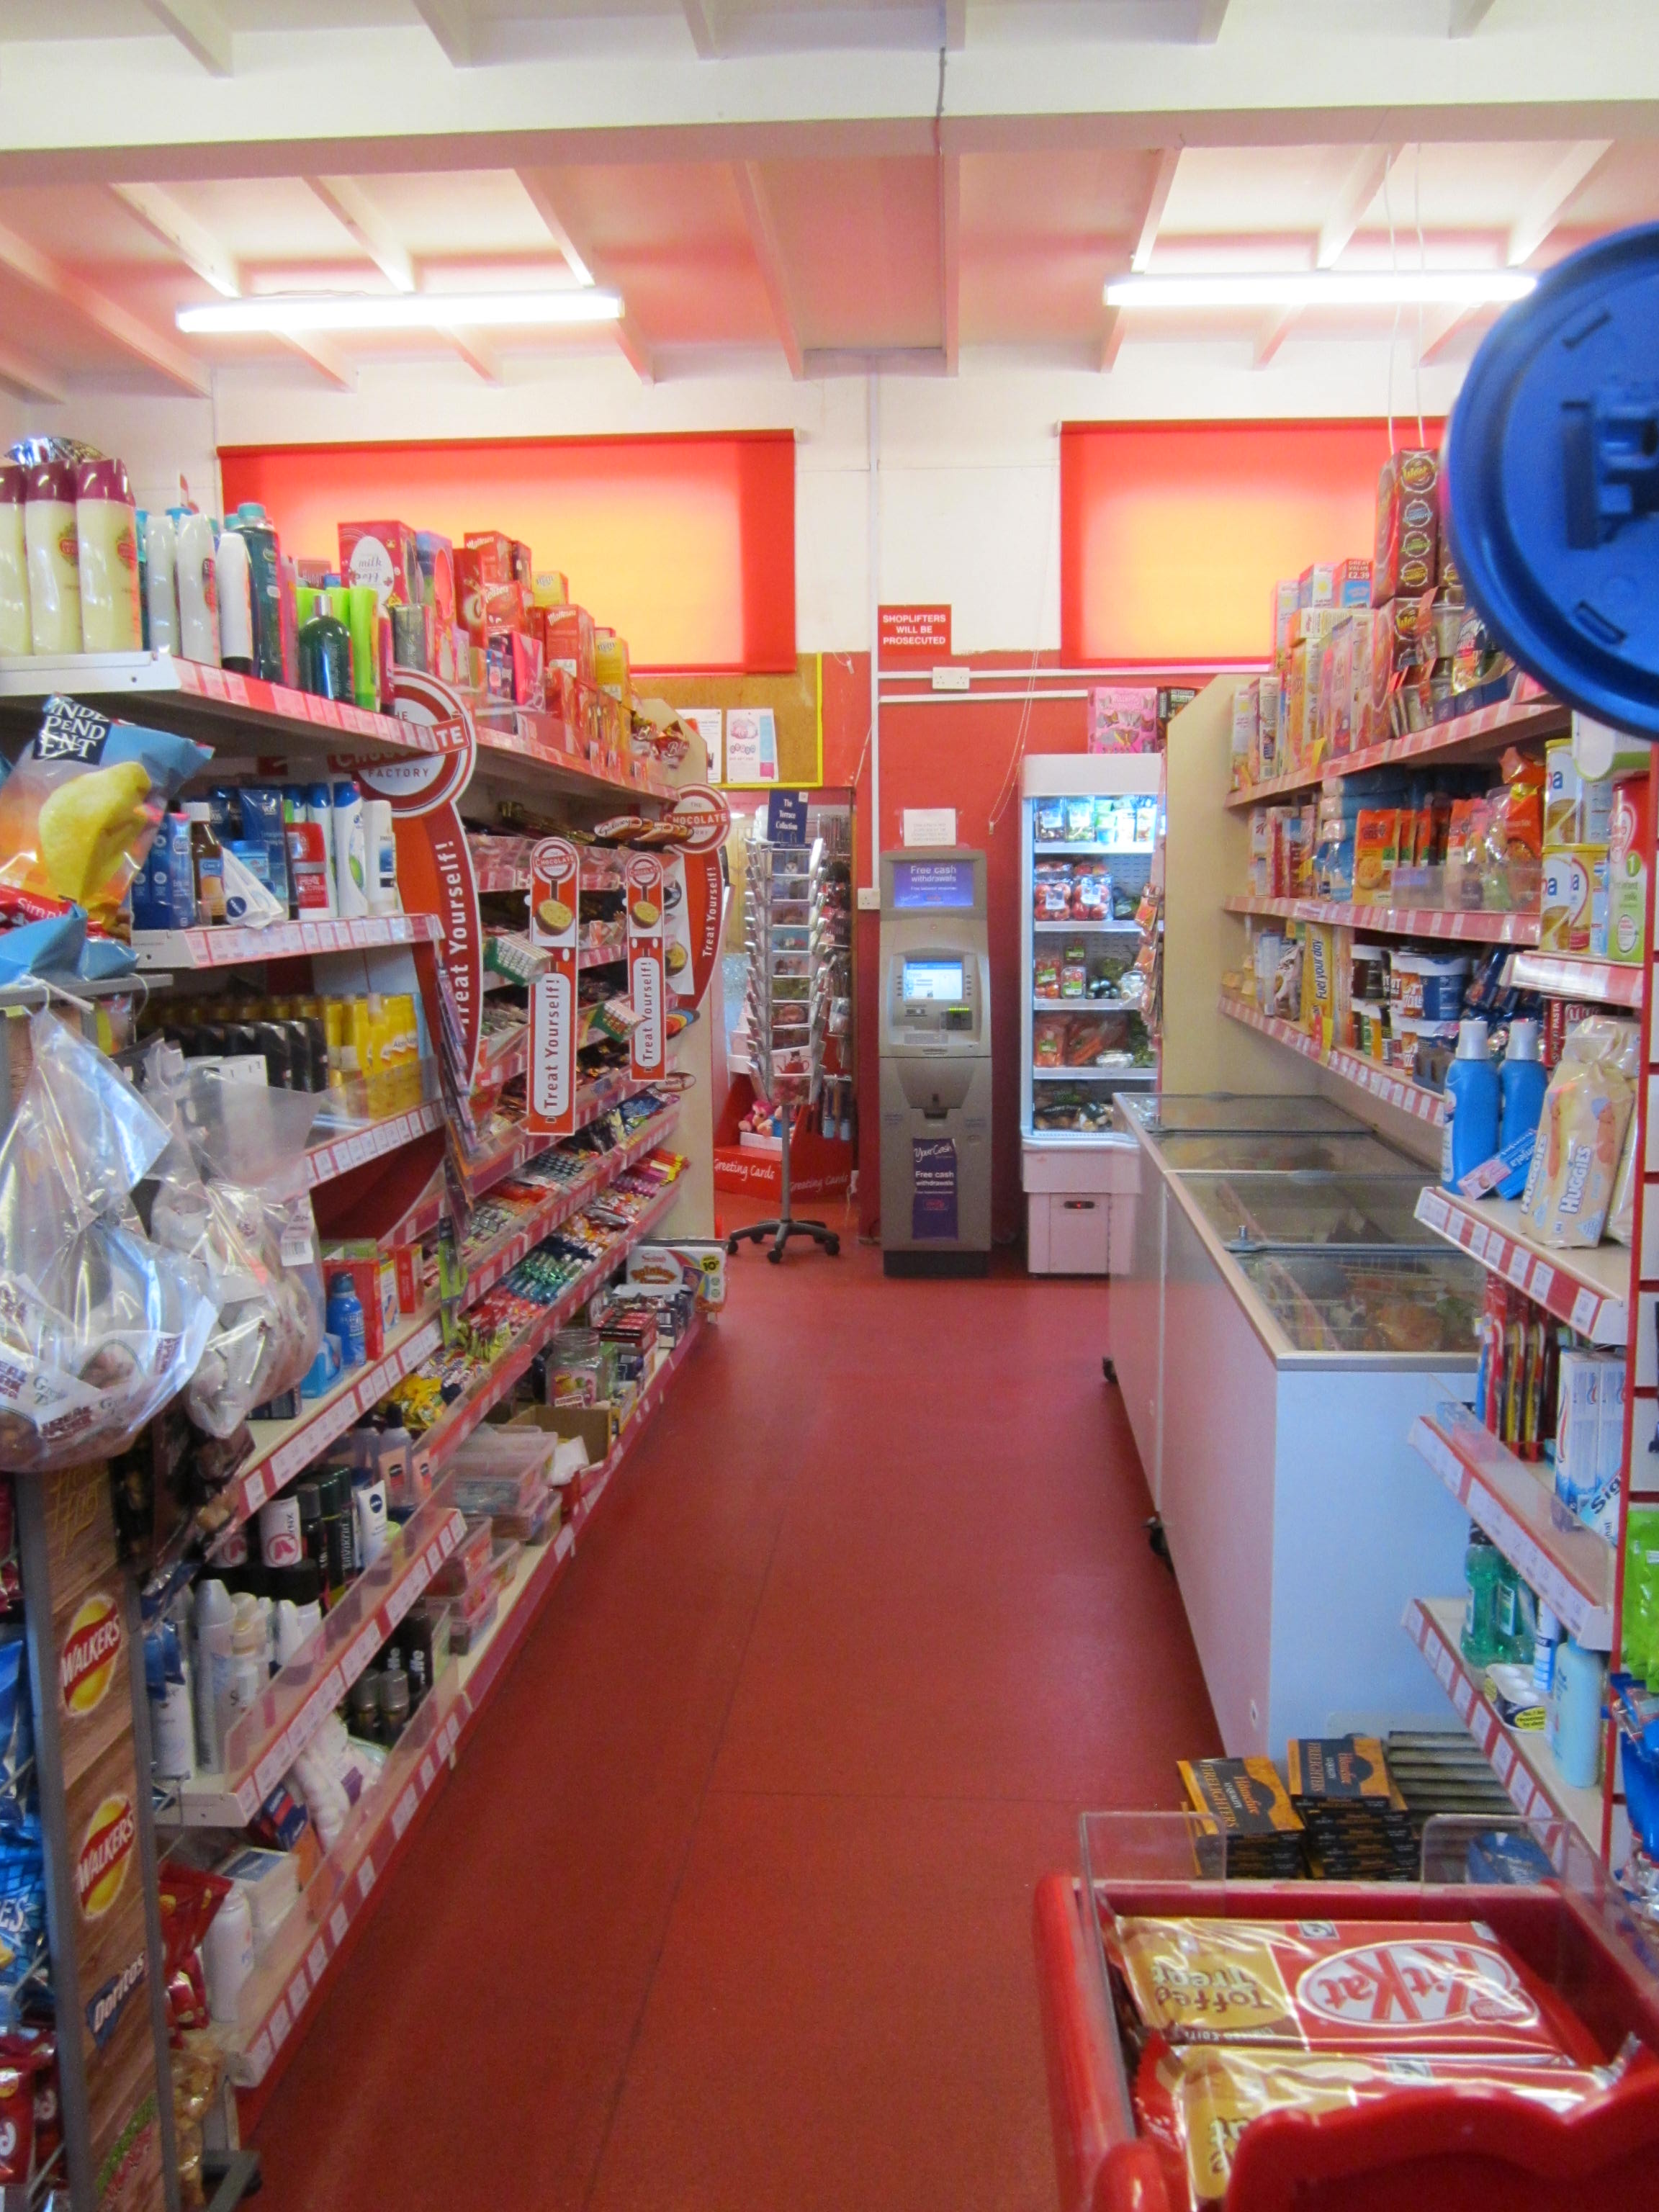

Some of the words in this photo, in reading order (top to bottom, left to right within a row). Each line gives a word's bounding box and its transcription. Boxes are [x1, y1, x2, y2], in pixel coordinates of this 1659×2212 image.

[883, 614, 946, 624] SHOPLIFTERS
[896, 626, 918, 634] WILL
[920, 626, 933, 634] BE
[883, 637, 946, 645] PROSECUTED
[45, 715, 107, 740] PEND
[368, 768, 430, 778] FACTORY
[779, 810, 796, 819] Terrace
[783, 799, 793, 808] The
[663, 814, 728, 827] CHOCOLATE
[775, 820, 798, 831] Collection
[535, 855, 575, 867] CHOCOLATE
[911, 866, 932, 874] Free
[934, 866, 956, 874] cash
[436, 839, 469, 953] Yourself!
[706, 865, 717, 920] Yourself!
[701, 922, 716, 958] Treat
[1311, 938, 1323, 957] day
[1314, 958, 1328, 981] your
[642, 960, 654, 1021] Yourself!
[1315, 978, 1327, 1000] Fuel
[545, 976, 561, 1058] Yourself!
[1552, 1002, 1560, 1028] PASTA
[642, 1023, 654, 1062] Treat
[544, 1061, 558, 1110] Treat
[914, 1144, 953, 1163] YourCash
[714, 1159, 748, 1182] Greeting
[750, 1164, 775, 1180] Cards
[935, 1170, 954, 1179] cash
[1559, 1145, 1591, 1215] HUGGIES
[60, 1617, 122, 1689] WALKERS
[76, 1812, 137, 1895] WALKERS
[94, 1950, 145, 2033] Doritos
[1155, 1983, 1273, 2014] Toffee
